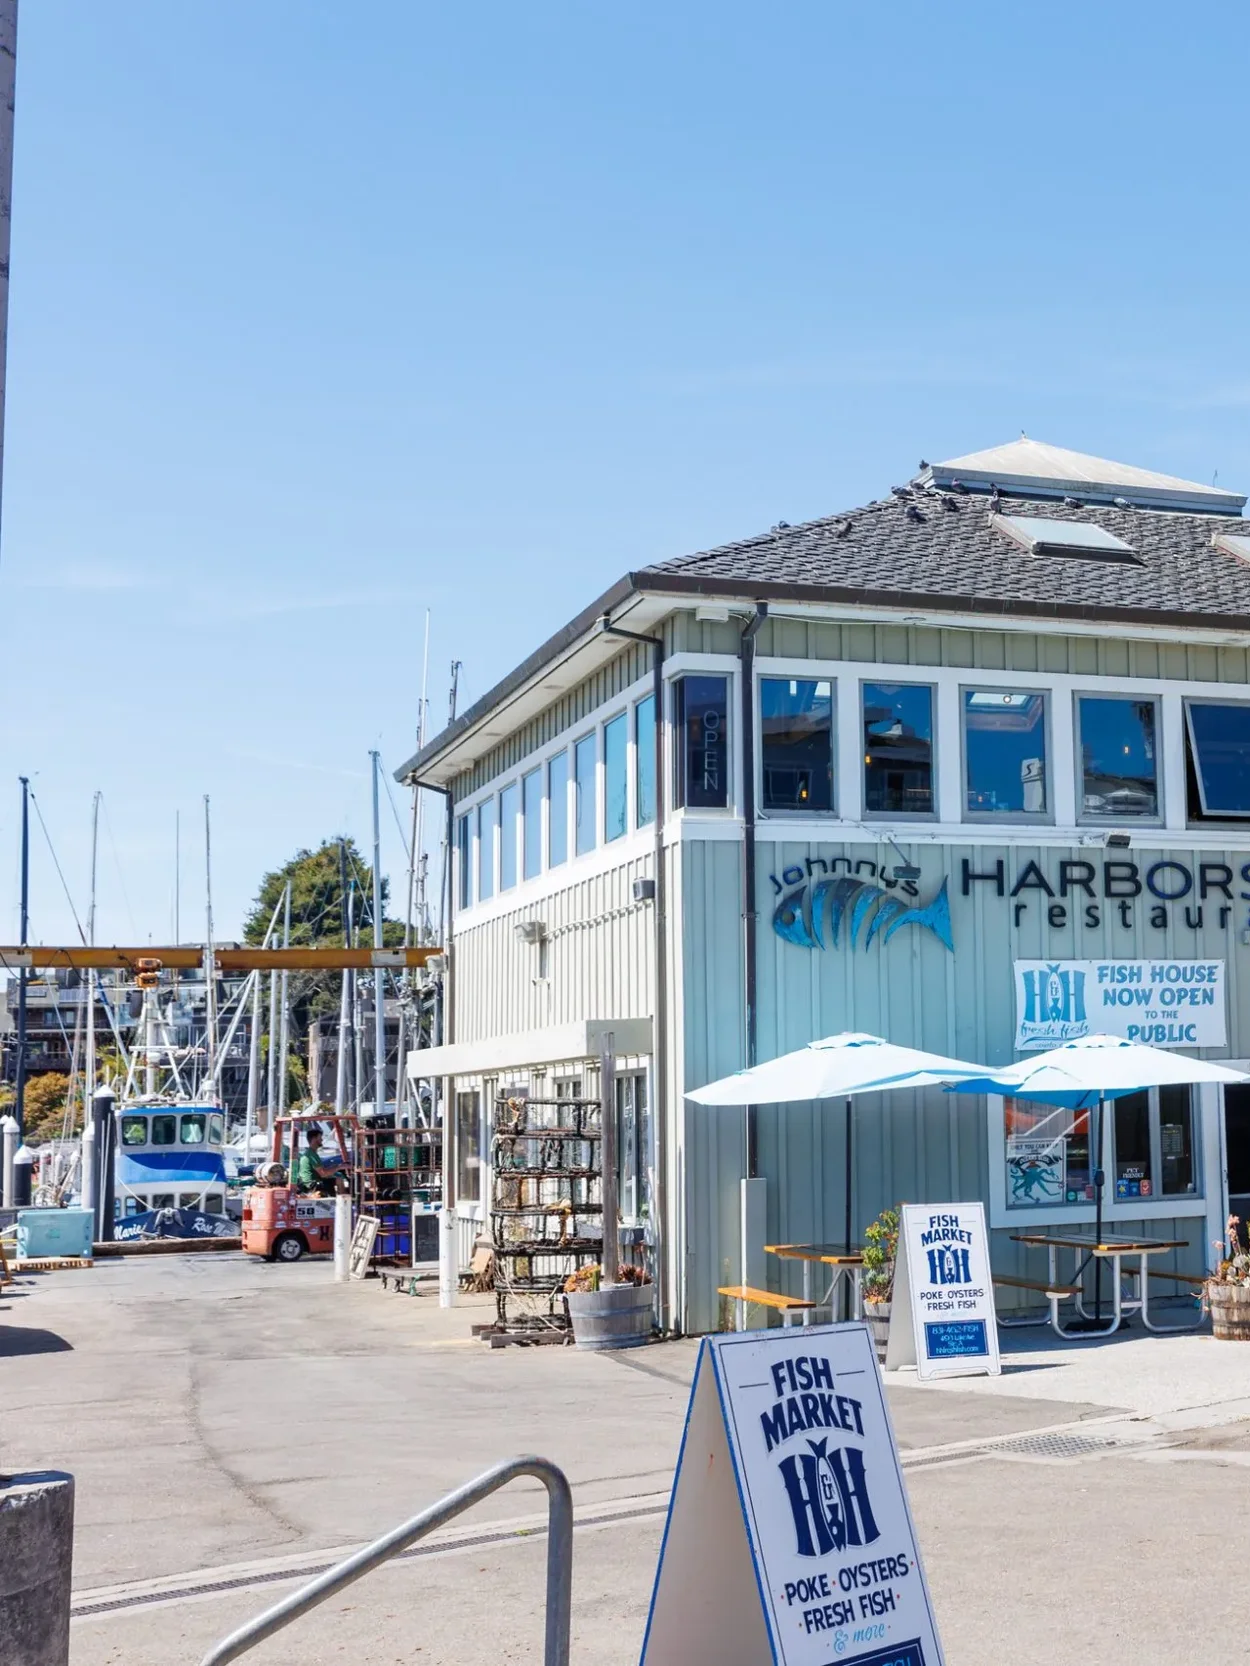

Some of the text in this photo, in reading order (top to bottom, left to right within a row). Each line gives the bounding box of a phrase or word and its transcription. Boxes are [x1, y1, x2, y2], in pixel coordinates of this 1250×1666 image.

[703, 710, 720, 790] OPEN
[1097, 964, 1218, 984] FISH HOUSE
[1103, 987, 1214, 1006] NOW OPEN
[1145, 1010, 1179, 1020] TO THE
[1127, 1023, 1197, 1043] PUBLIC
[929, 1214, 959, 1228] FISH
[920, 1228, 972, 1247] MARKET
[920, 1288, 984, 1300] POKE OYSTERS
[927, 1300, 976, 1311] FRESH FISH
[771, 1356, 835, 1397] FISH
[760, 1393, 865, 1453] MARKET
[784, 1553, 909, 1606] POKE OYSTERS
[803, 1587, 896, 1634] FRESH FISH
[834, 1623, 885, 1655] & more
